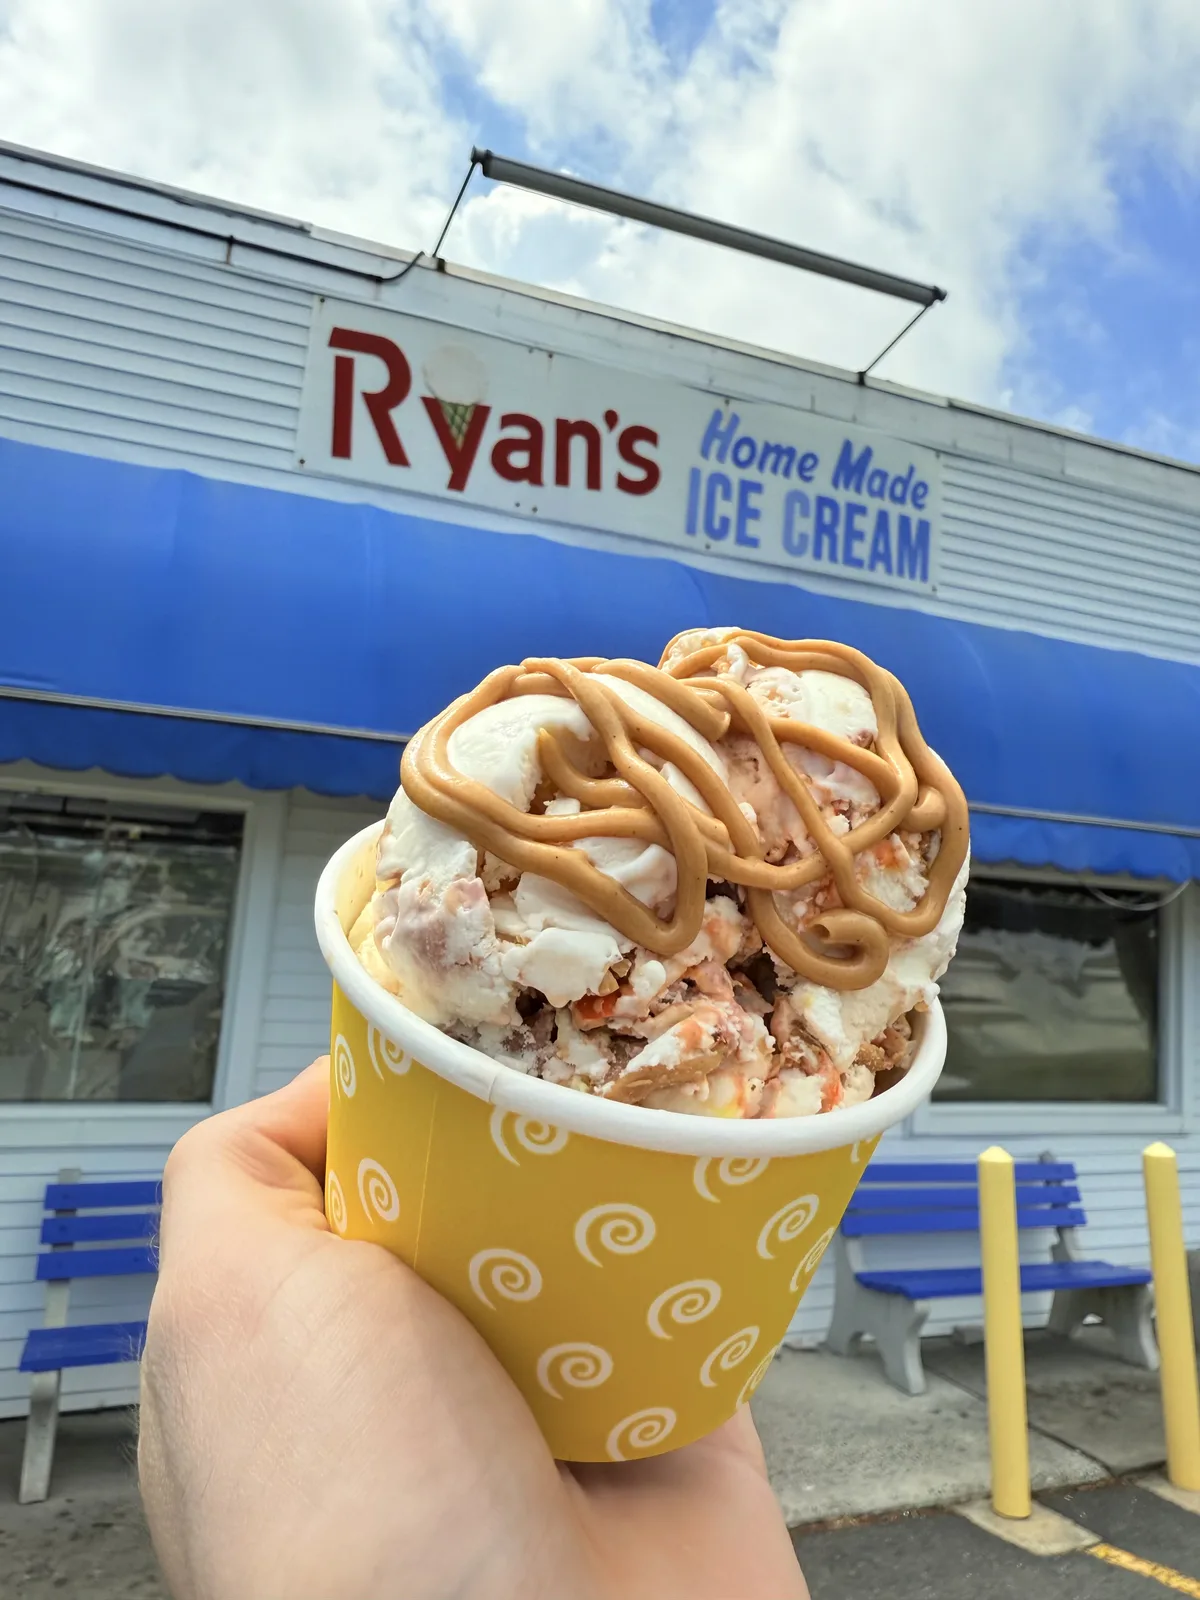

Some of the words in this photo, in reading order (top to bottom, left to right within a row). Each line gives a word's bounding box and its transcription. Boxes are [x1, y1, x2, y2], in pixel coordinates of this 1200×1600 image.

[328, 326, 661, 496] Ryan's
[700, 408, 819, 483] Home
[831, 438, 929, 510] Made
[685, 467, 763, 548] ICE
[782, 489, 930, 583] CREAM
